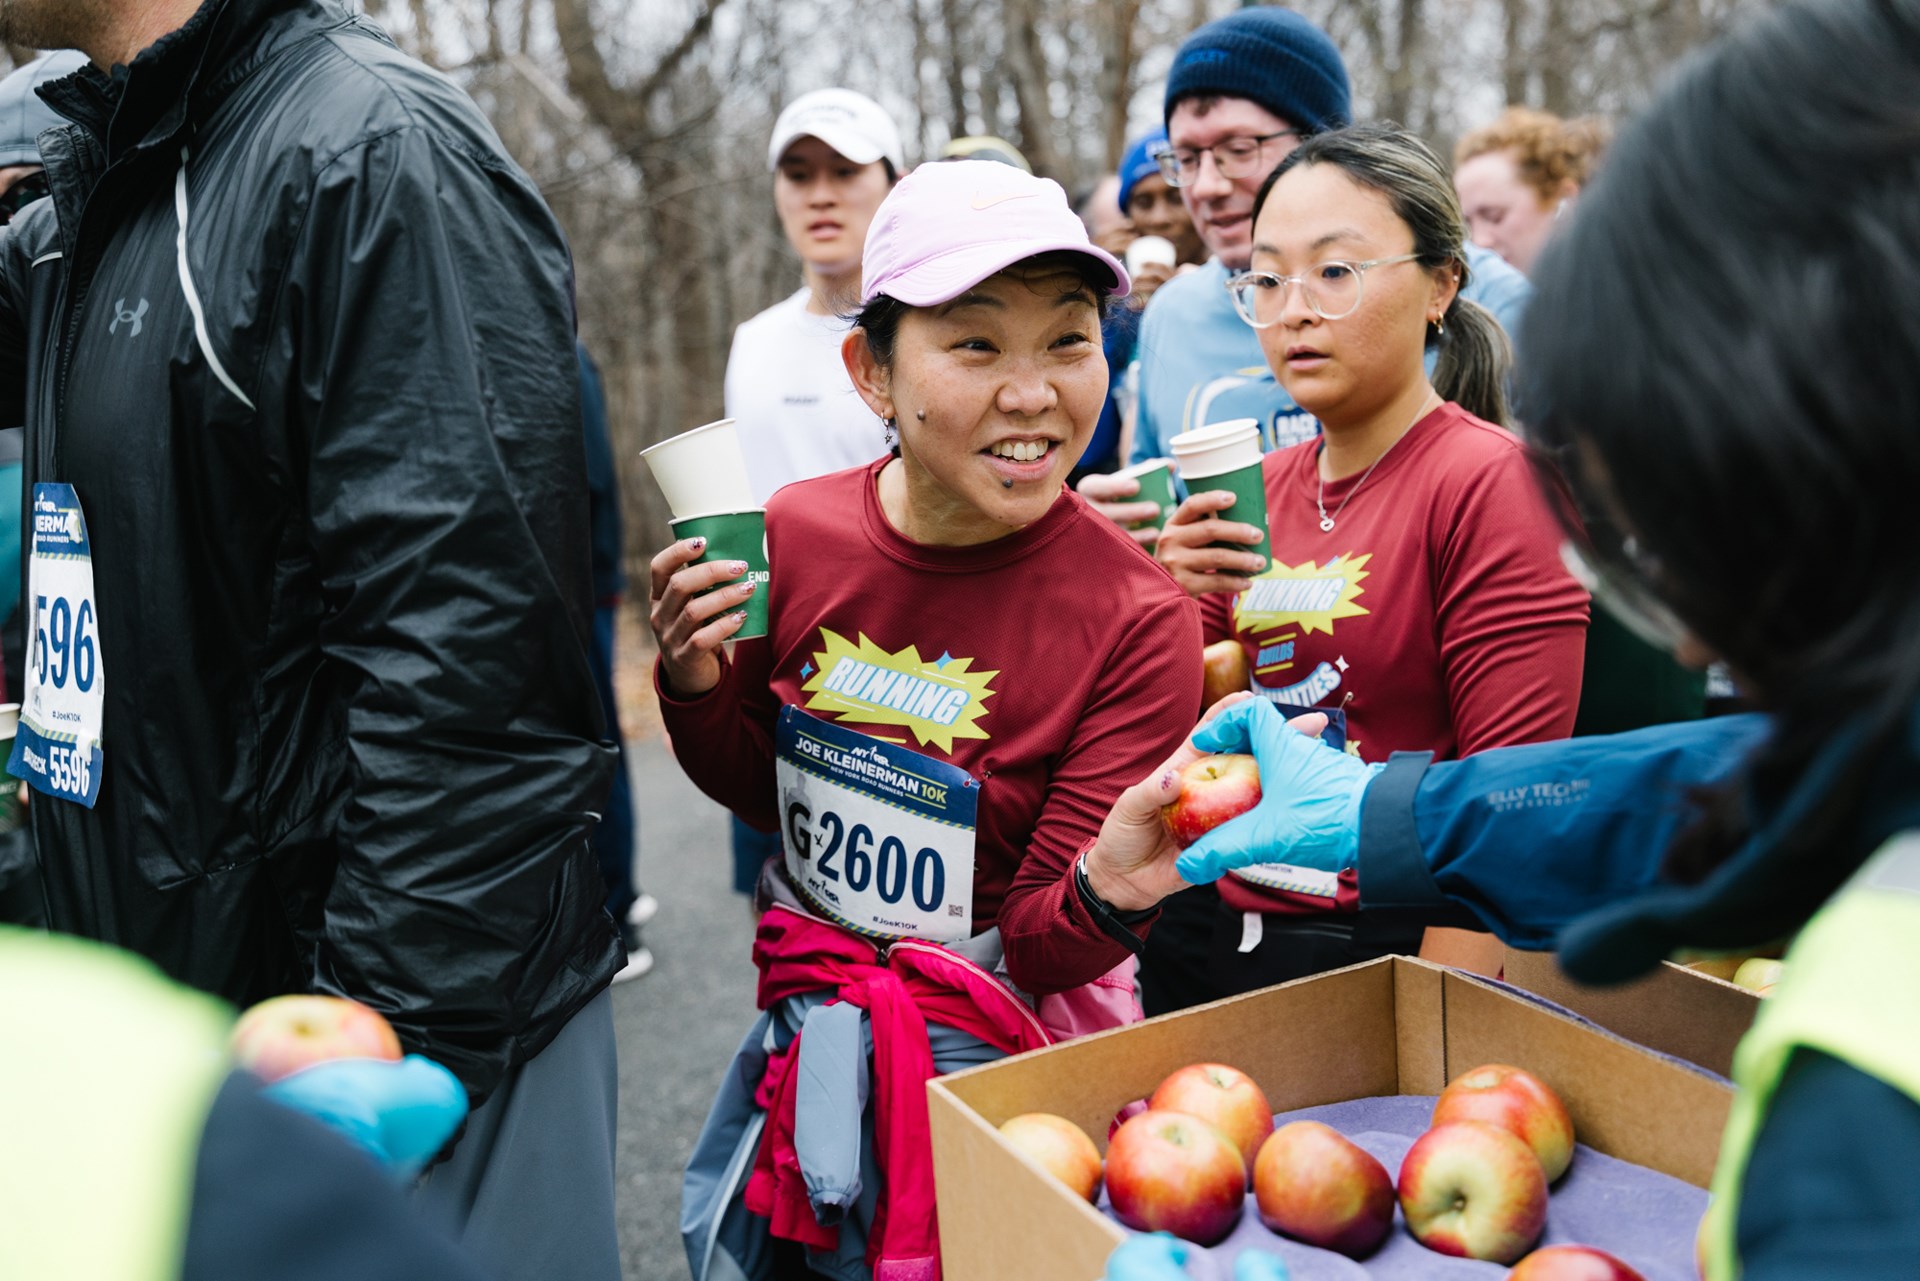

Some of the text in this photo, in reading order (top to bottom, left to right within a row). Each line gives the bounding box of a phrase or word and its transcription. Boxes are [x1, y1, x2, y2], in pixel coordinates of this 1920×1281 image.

[748, 571, 770, 582] END
[1242, 577, 1346, 612] RUNNING
[1257, 641, 1295, 667] BUILDS
[823, 656, 972, 726] RUNNING
[52, 710, 81, 722] #JoeK10K
[50, 745, 90, 797] 5596
[795, 737, 947, 804] JOE KLEINERMAN 10K
[830, 765, 904, 797] NEW YORK ROAD RUNNERS
[817, 811, 945, 912] 2600
[872, 916, 918, 931] #JoeK10K
